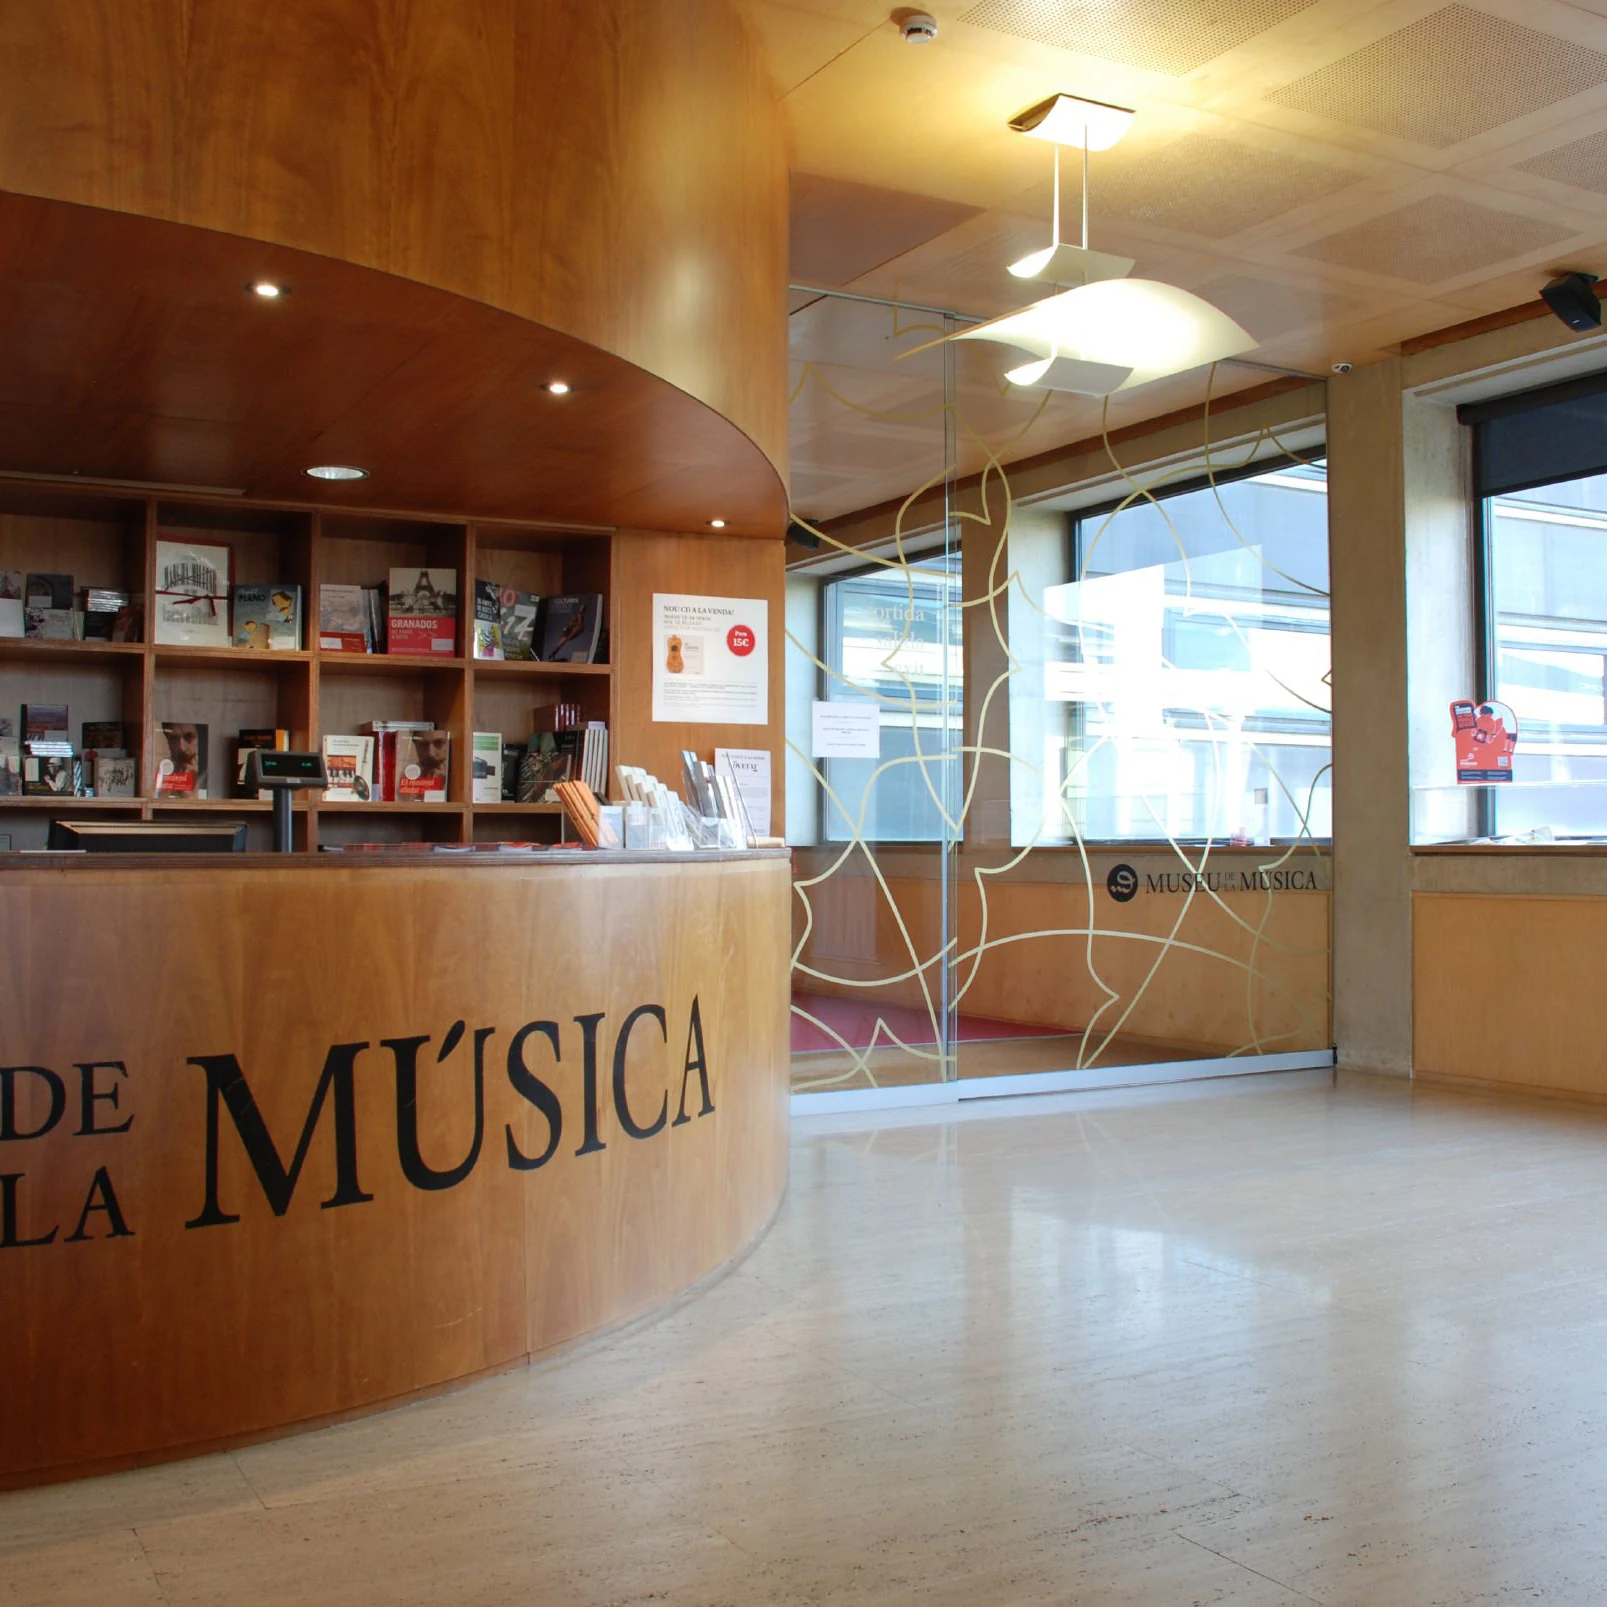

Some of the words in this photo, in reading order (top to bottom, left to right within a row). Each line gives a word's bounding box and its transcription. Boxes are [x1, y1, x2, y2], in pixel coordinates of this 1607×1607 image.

[238, 594, 266, 602] PIANO
[391, 619, 438, 629] GRANADOS
[733, 638, 749, 647] 15€
[876, 631, 924, 649] salida
[1146, 872, 1221, 895] MUSEU
[1224, 871, 1237, 881] DE
[1239, 869, 1317, 892] MÚSICA
[0, 1061, 135, 1142] DE
[184, 993, 716, 1231] MÚSICA
[0, 1165, 135, 1248] LA
